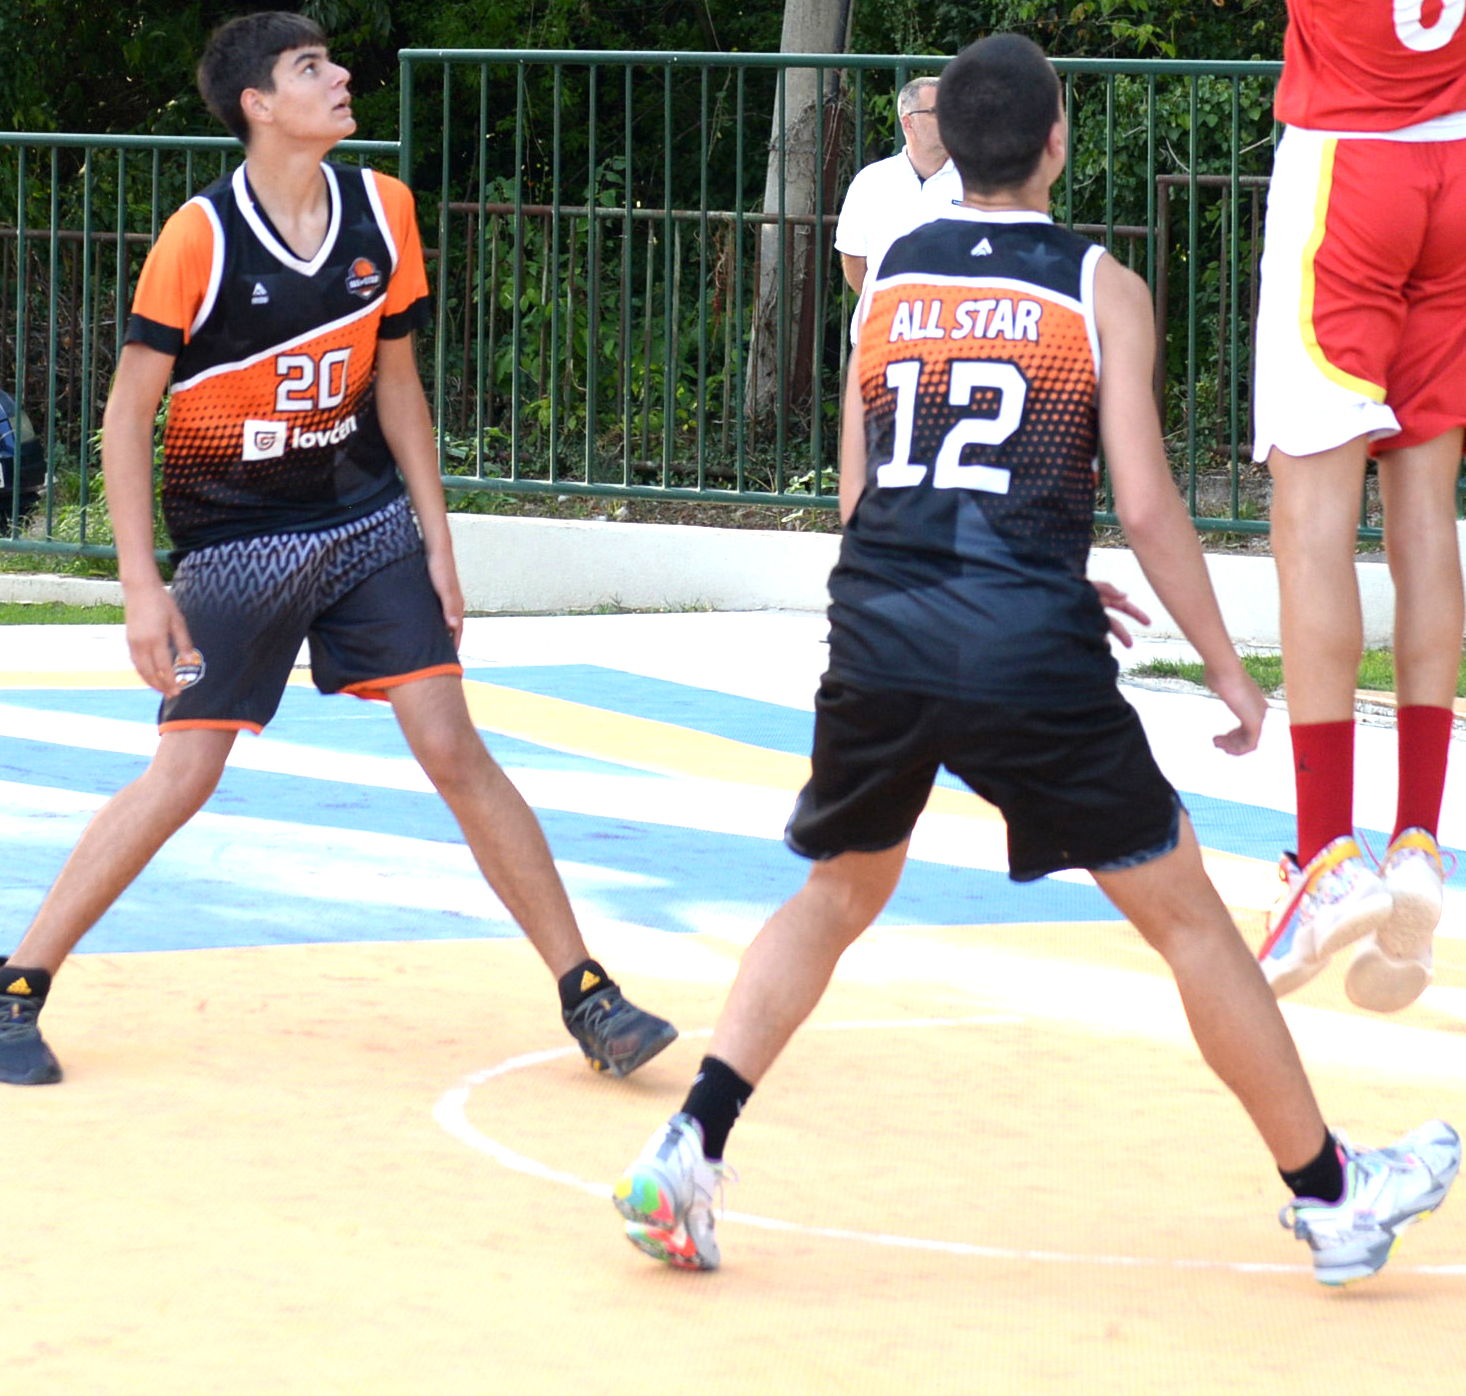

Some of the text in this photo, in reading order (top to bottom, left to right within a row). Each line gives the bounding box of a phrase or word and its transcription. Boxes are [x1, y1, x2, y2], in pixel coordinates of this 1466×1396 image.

[888, 298, 1042, 343] ALL STAR
[275, 347, 353, 412] 20
[877, 361, 1027, 494] 12
